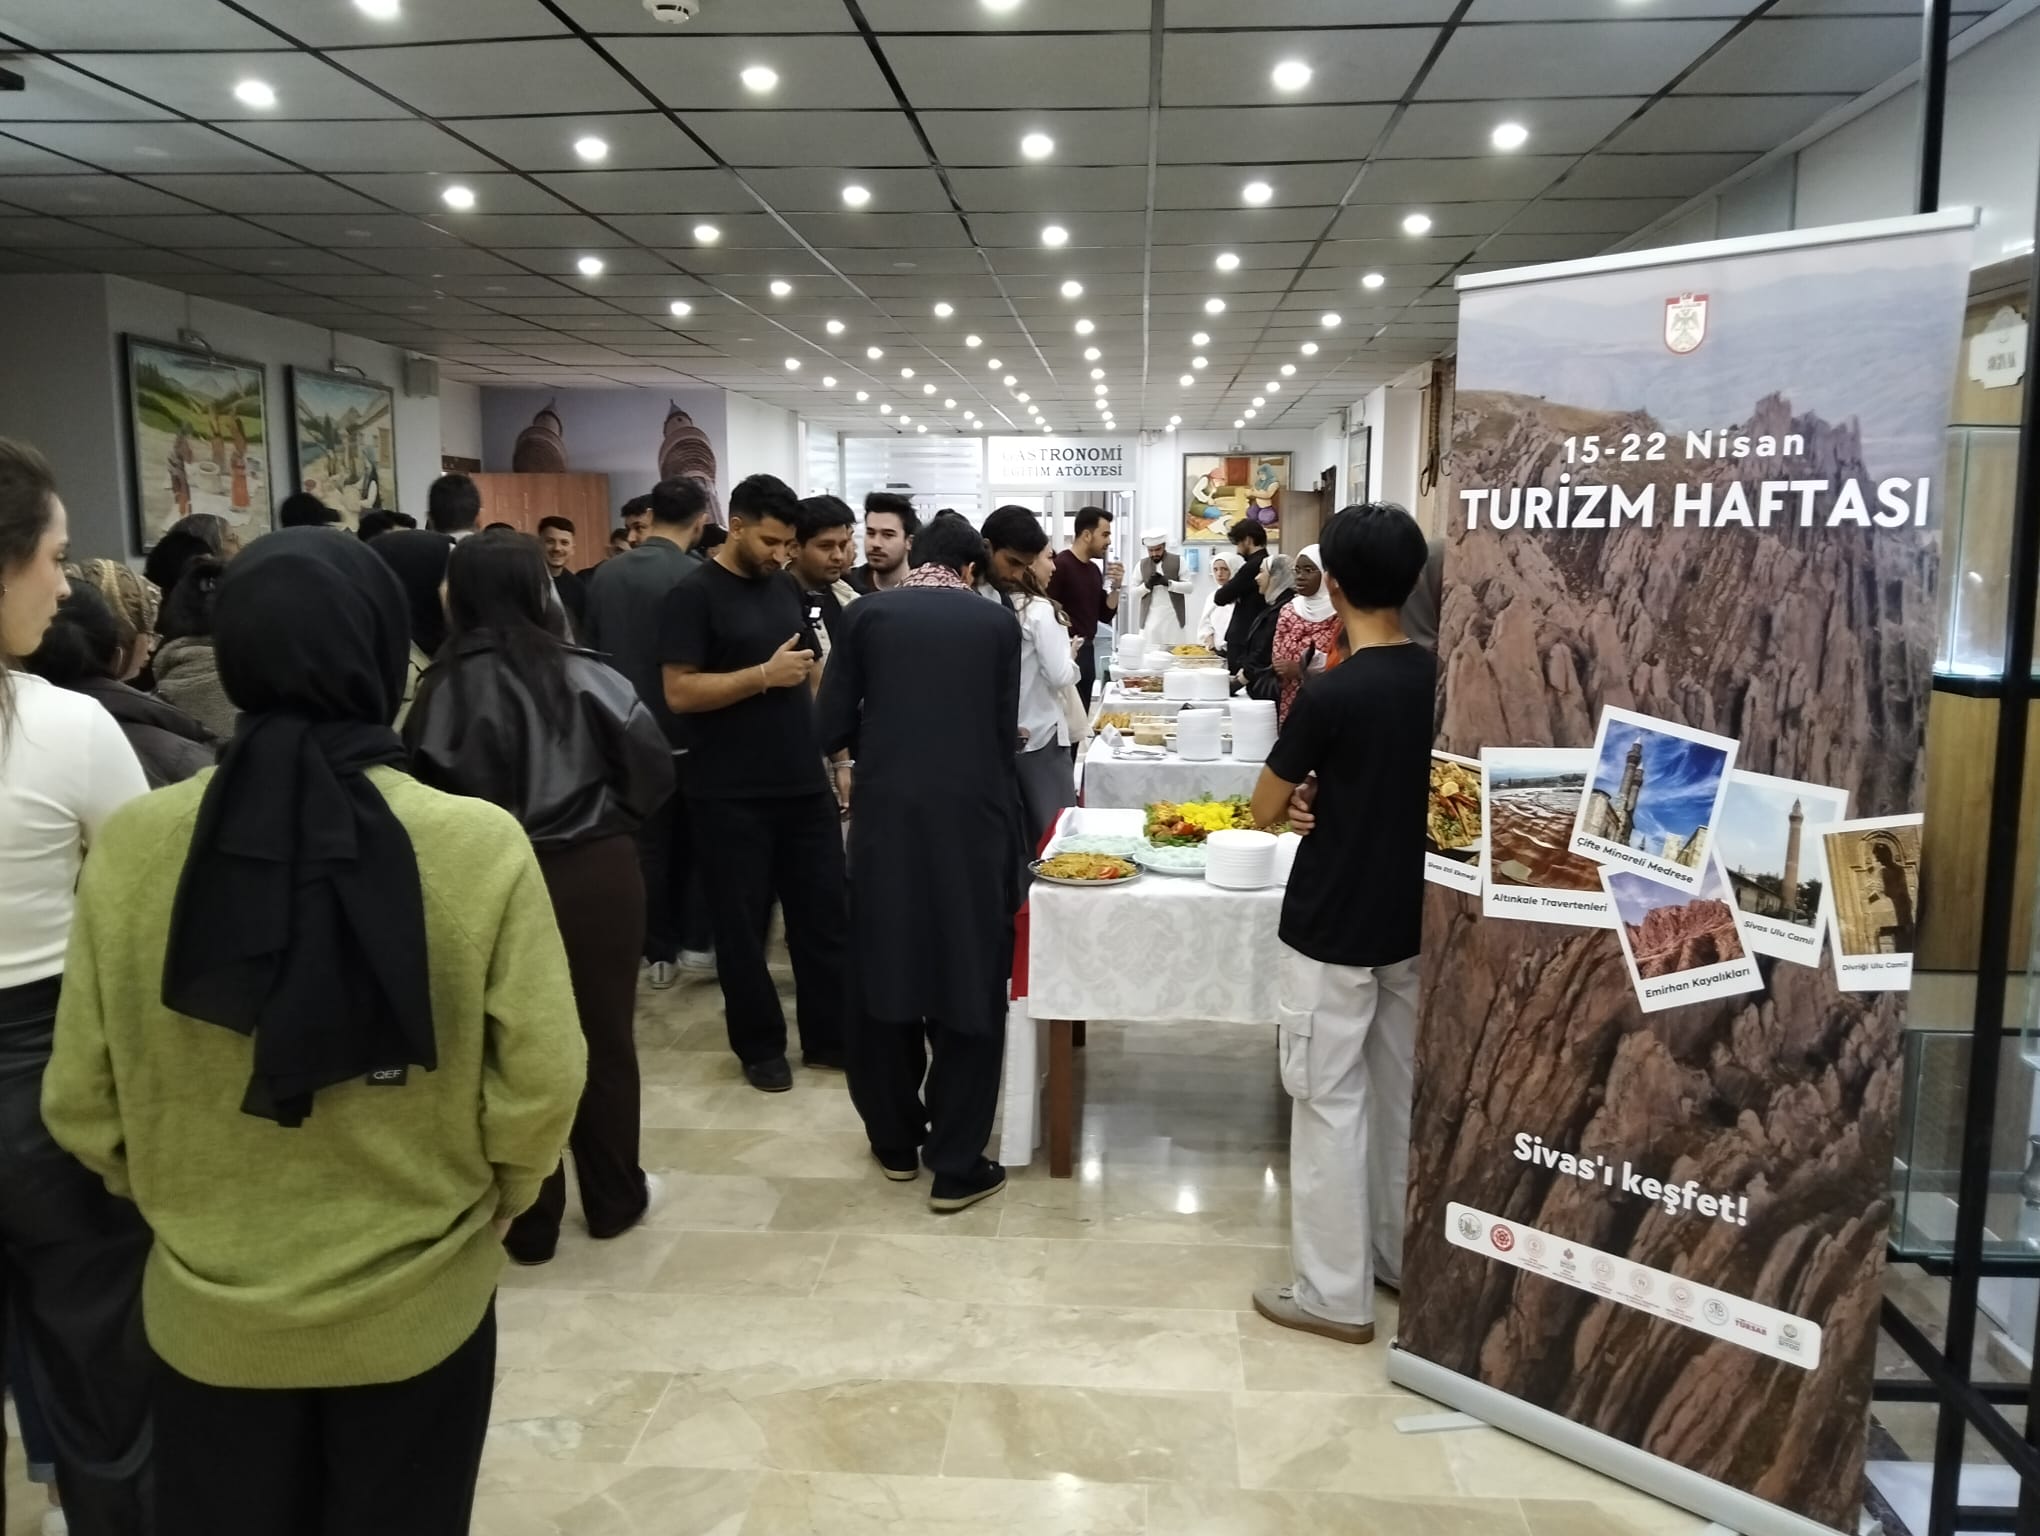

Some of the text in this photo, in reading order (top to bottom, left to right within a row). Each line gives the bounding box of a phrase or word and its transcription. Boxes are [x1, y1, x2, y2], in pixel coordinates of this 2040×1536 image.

[1563, 429, 1804, 464] 15-22 Nisan
[1056, 463, 1123, 477] ATÖLYESİ
[1459, 472, 1931, 530] TURİZM HAFTASI
[1577, 837, 1694, 883] Çifte Minareli Medrese
[1492, 893, 1607, 912] Altınkale Travertenleri
[1743, 920, 1768, 933] Sivas
[1770, 927, 1786, 938] Ulu
[1645, 968, 1750, 998] Emirhan Kayalıkları
[1513, 1132, 1749, 1227] Sivas'ı keşfet!
